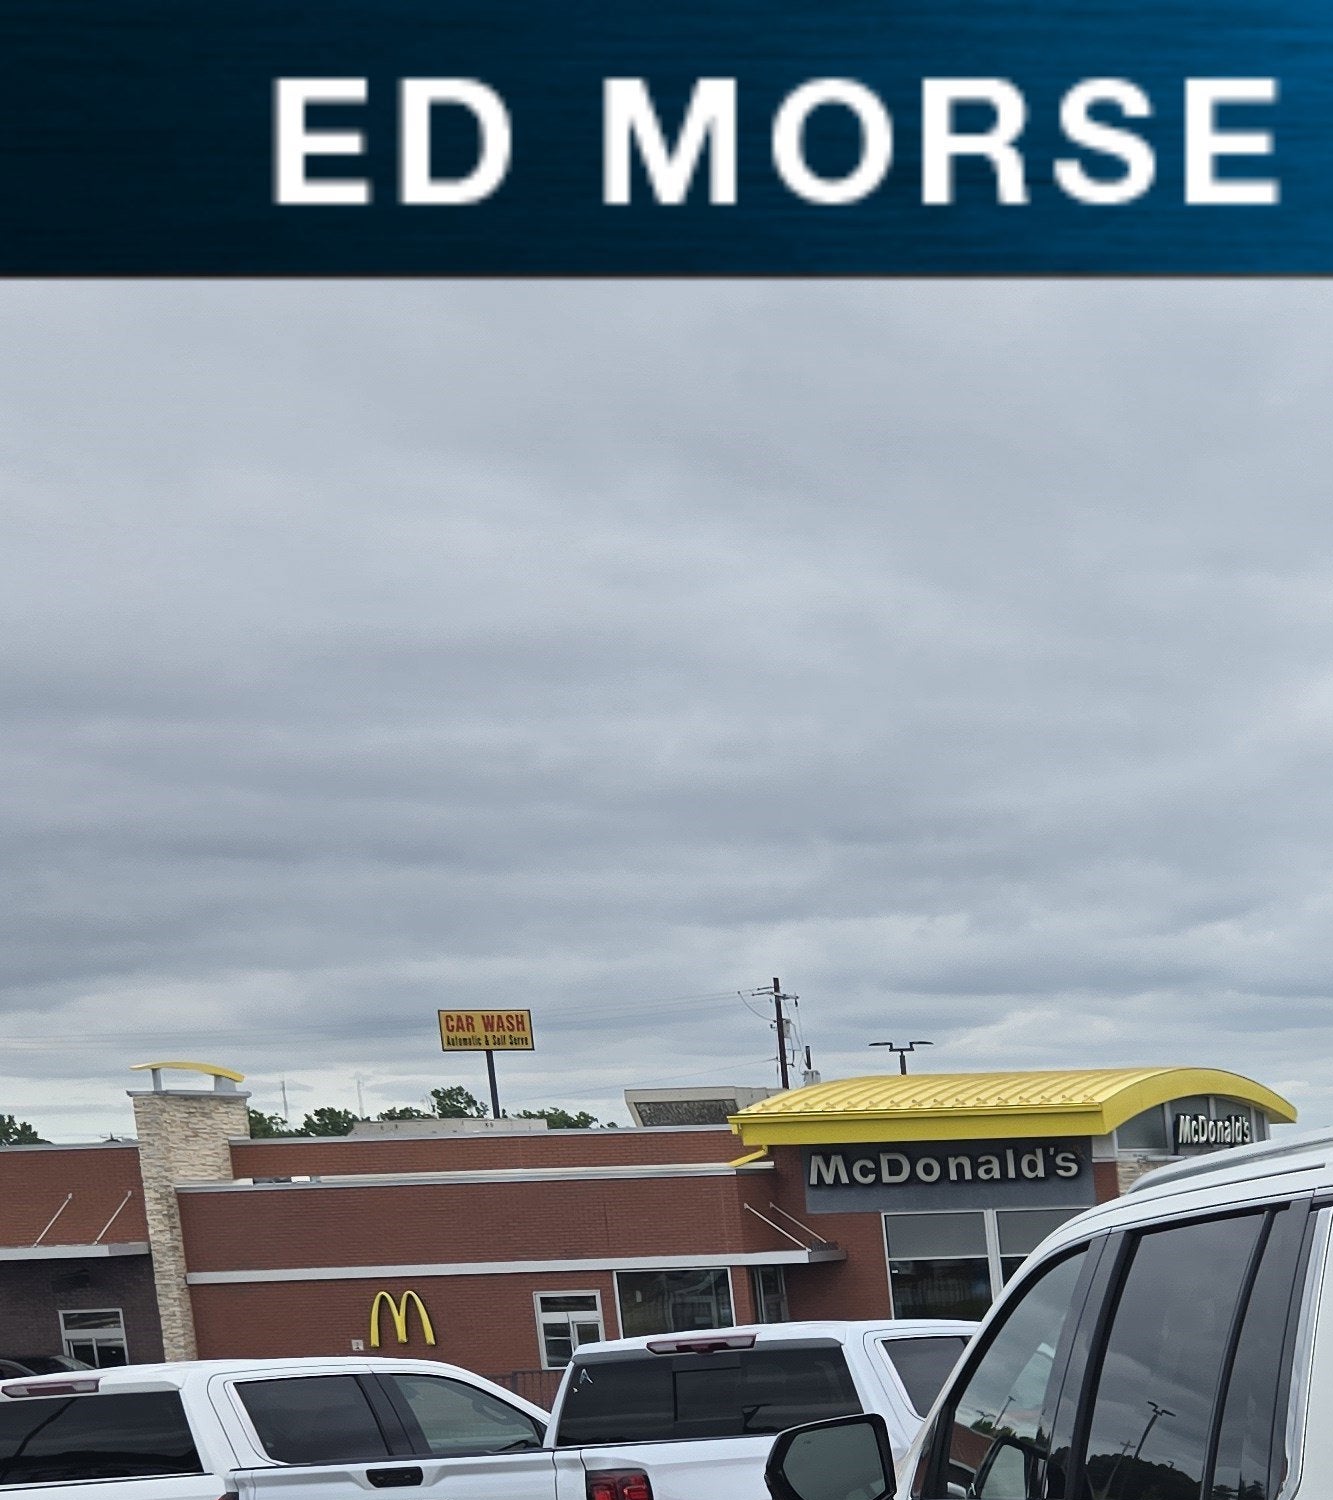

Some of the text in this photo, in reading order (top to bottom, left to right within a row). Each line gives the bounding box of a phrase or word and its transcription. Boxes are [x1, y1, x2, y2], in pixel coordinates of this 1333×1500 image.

[445, 1014, 526, 1033] CAR WASH
[446, 1035, 482, 1047] Automatic
[1177, 1113, 1252, 1145] McDonald's
[808, 1147, 1080, 1186] McDonald's
